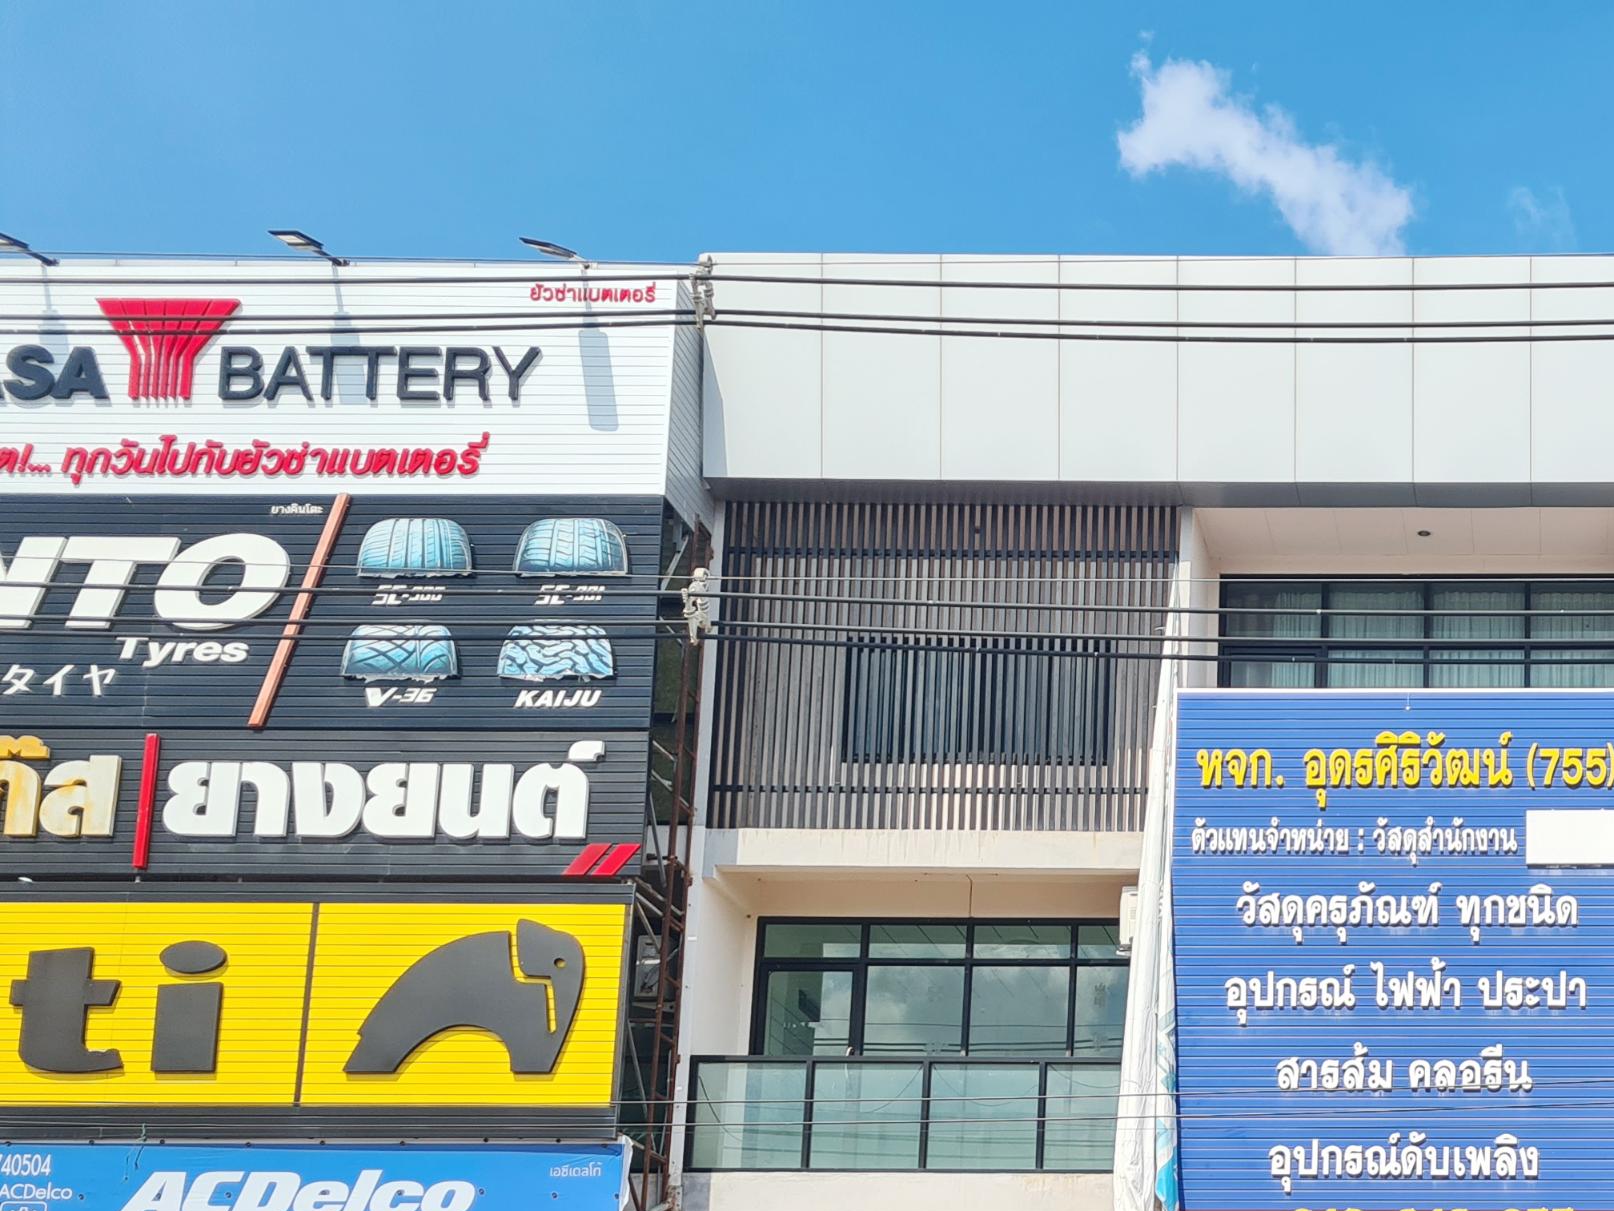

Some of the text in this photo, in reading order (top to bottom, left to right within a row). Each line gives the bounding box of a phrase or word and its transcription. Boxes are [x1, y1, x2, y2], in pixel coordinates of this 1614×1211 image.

[530, 281, 656, 303] ยัวซ่าแบตเตอรี่
[0, 344, 543, 401] SA BATTERY
[61, 432, 490, 486] ทุกวันไปกับยัวซ่าแบตเตอรี่
[116, 637, 249, 668] Tyres
[2, 664, 116, 696] タイヤ
[365, 687, 437, 708] V-36
[513, 689, 602, 708] KAIJU
[162, 740, 606, 839] ยางยนต์
[1197, 747, 1285, 788] หจก.
[1304, 731, 1514, 808] อุดรศิริวัฒน์
[1191, 817, 1350, 855] ตัวแทนจำหน่าย
[1373, 816, 1518, 866] วัสดุสำนักงาน
[1237, 881, 1578, 944] วัสดุครุภัณฑ์ ทุกชนิด
[10, 940, 228, 1075] ti
[1224, 957, 1588, 1027] อุปกรณ์ ไฟฟ้า ประปา
[1275, 1042, 1534, 1092] สารส้ม คลอรีน
[0, 1154, 51, 1176] 40504
[1269, 1131, 1540, 1194] อุปกรณ์ดับเพลิง
[0, 1183, 72, 1200] ACDelco
